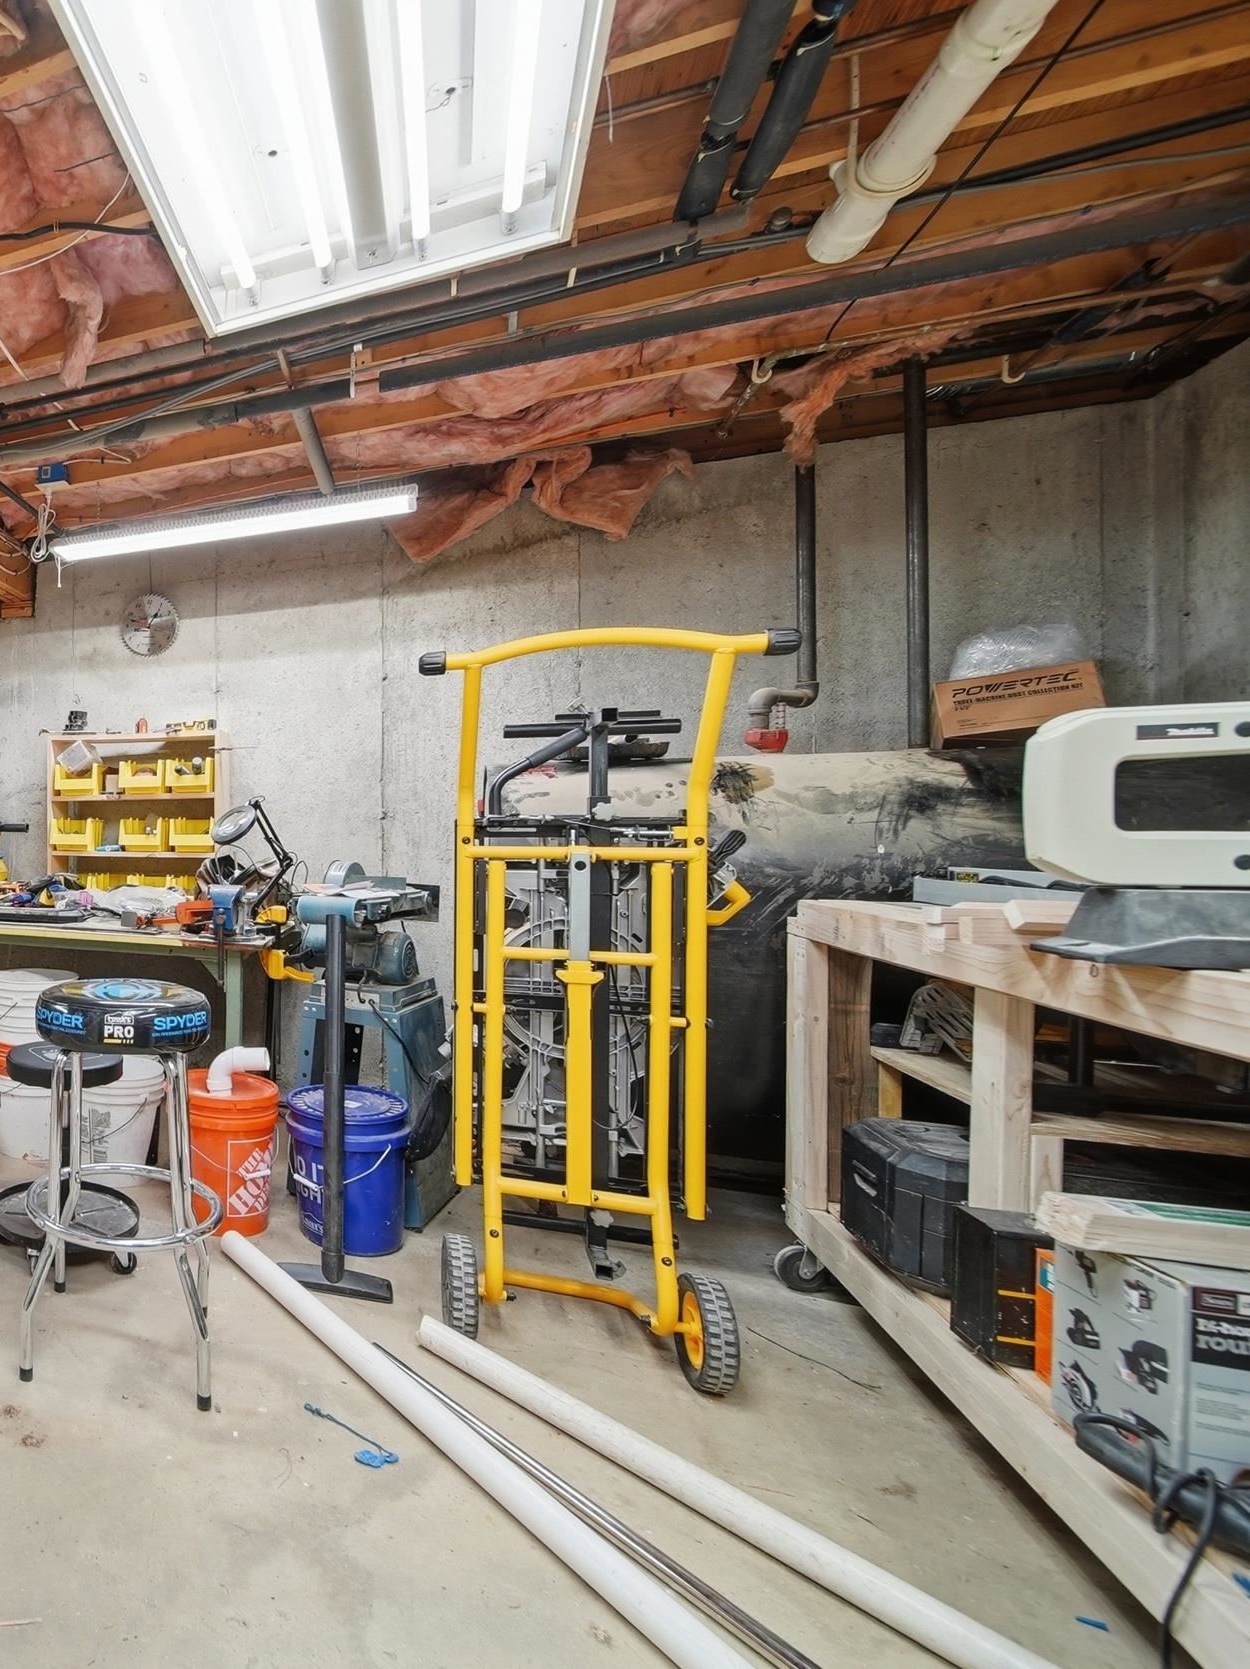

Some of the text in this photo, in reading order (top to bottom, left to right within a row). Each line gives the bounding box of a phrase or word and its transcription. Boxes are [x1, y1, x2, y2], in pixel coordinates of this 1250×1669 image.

[952, 669, 1079, 699] POWERTEC
[37, 1007, 84, 1029] SPYDER
[153, 1011, 207, 1031] SPYDER
[104, 1025, 135, 1039] PRO
[237, 1147, 264, 1180] THE
